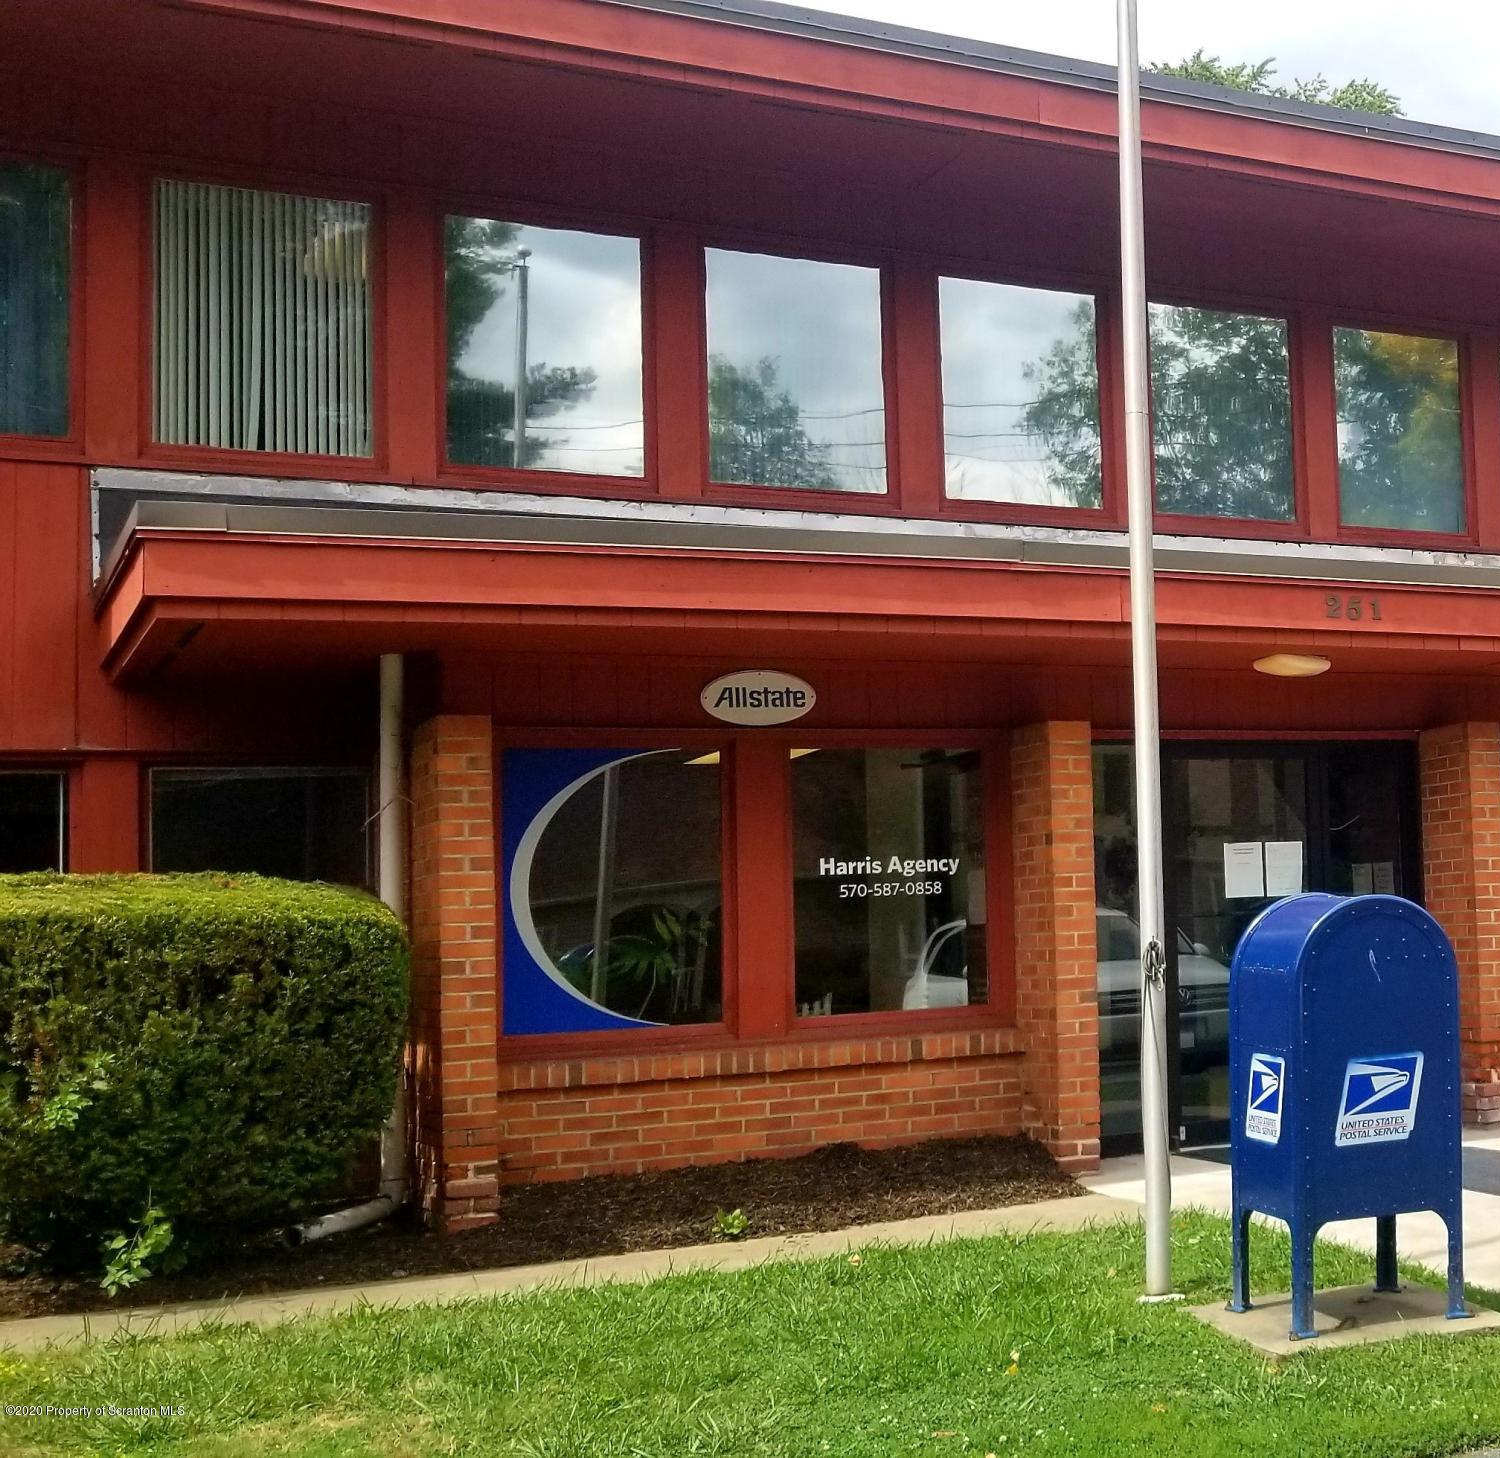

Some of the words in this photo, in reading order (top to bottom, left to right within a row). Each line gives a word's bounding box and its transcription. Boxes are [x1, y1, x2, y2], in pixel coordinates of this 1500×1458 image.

[1325, 594, 1382, 620] 251
[713, 686, 806, 708] Allstate
[819, 856, 882, 876] Harris
[887, 855, 960, 877] Agency
[839, 881, 942, 898] 570-587-0858
[1341, 1119, 1374, 1130] UNITED
[1375, 1115, 1405, 1126] STATES
[1339, 1129, 1371, 1141] POSTAL
[1373, 1125, 1408, 1137] SERVICE
